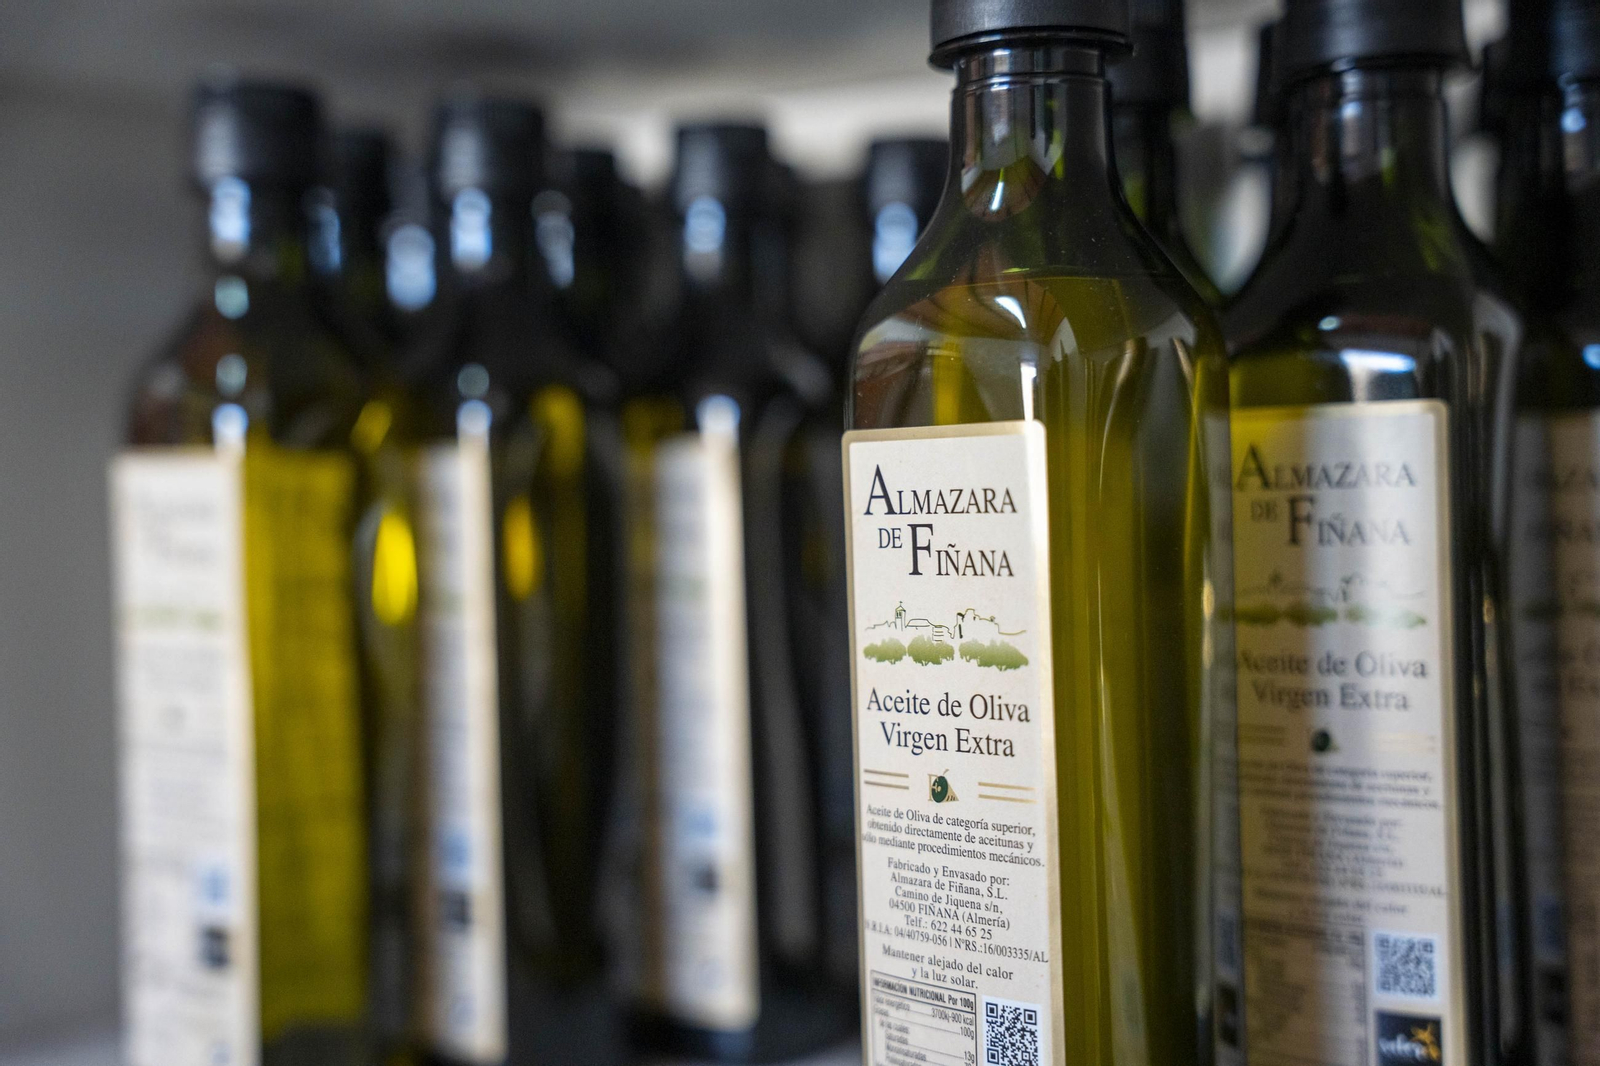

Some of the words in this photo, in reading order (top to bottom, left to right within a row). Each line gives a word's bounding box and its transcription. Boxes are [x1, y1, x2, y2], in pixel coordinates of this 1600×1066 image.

[863, 464, 1018, 516] ALMAZARA
[877, 528, 903, 549] DE
[907, 523, 1015, 577] FIÑANA
[1316, 652, 1346, 677] de
[1355, 652, 1428, 679] Oliva
[866, 687, 931, 715] Aceite
[937, 692, 963, 717] de
[969, 693, 1030, 723] Oliva
[1252, 681, 1329, 712] Virgen
[1339, 684, 1409, 711] Extra
[880, 721, 949, 755] Virgen
[954, 727, 1015, 757] Extra
[866, 804, 891, 817] Aceite
[893, 808, 904, 819] de
[906, 809, 931, 823] Oliva
[932, 813, 944, 824] de
[945, 816, 989, 831] categoría
[991, 822, 1036, 837] superior,
[867, 818, 902, 833] obtenido
[904, 823, 962, 842] directamente
[964, 831, 976, 844] de
[978, 834, 1024, 850] aceitunas
[1027, 840, 1034, 853] y
[878, 835, 916, 850] mediante
[917, 842, 987, 861] procedimientos
[989, 852, 1045, 868] mecánicos.
[887, 857, 931, 874] Fabricado
[933, 866, 939, 878] y
[942, 865, 987, 883] Envasado
[989, 875, 1010, 887] por:
[890, 871, 932, 888] Almazara
[934, 879, 946, 890] de
[948, 880, 984, 897] Fiñana,
[987, 886, 1008, 900] S.L.
[888, 897, 916, 913] 04500
[918, 902, 960, 921] FIÑANA
[962, 911, 1010, 931] (Almería)
[895, 885, 929, 901] Camino
[931, 892, 943, 904] de
[945, 894, 982, 911] Jiquena
[984, 900, 1003, 915] s/n,
[904, 913, 928, 929] Telf.:
[930, 919, 948, 933] 622
[950, 923, 962, 935] 44
[965, 925, 977, 938] 65
[980, 928, 993, 940] 25
[882, 943, 925, 963] Mantener
[927, 954, 964, 971] alejado
[966, 961, 983, 975] del
[985, 966, 1014, 980] calor
[911, 967, 918, 979] y
[920, 966, 930, 979] la
[932, 968, 948, 983] luz
[950, 974, 979, 989] solar.
[908, 986, 947, 1004] NUTRICIONAL
[947, 994, 959, 1006] Por
[960, 997, 974, 1011] 100g
[960, 1026, 975, 1041] 100g
[964, 1050, 975, 1064] 13g
